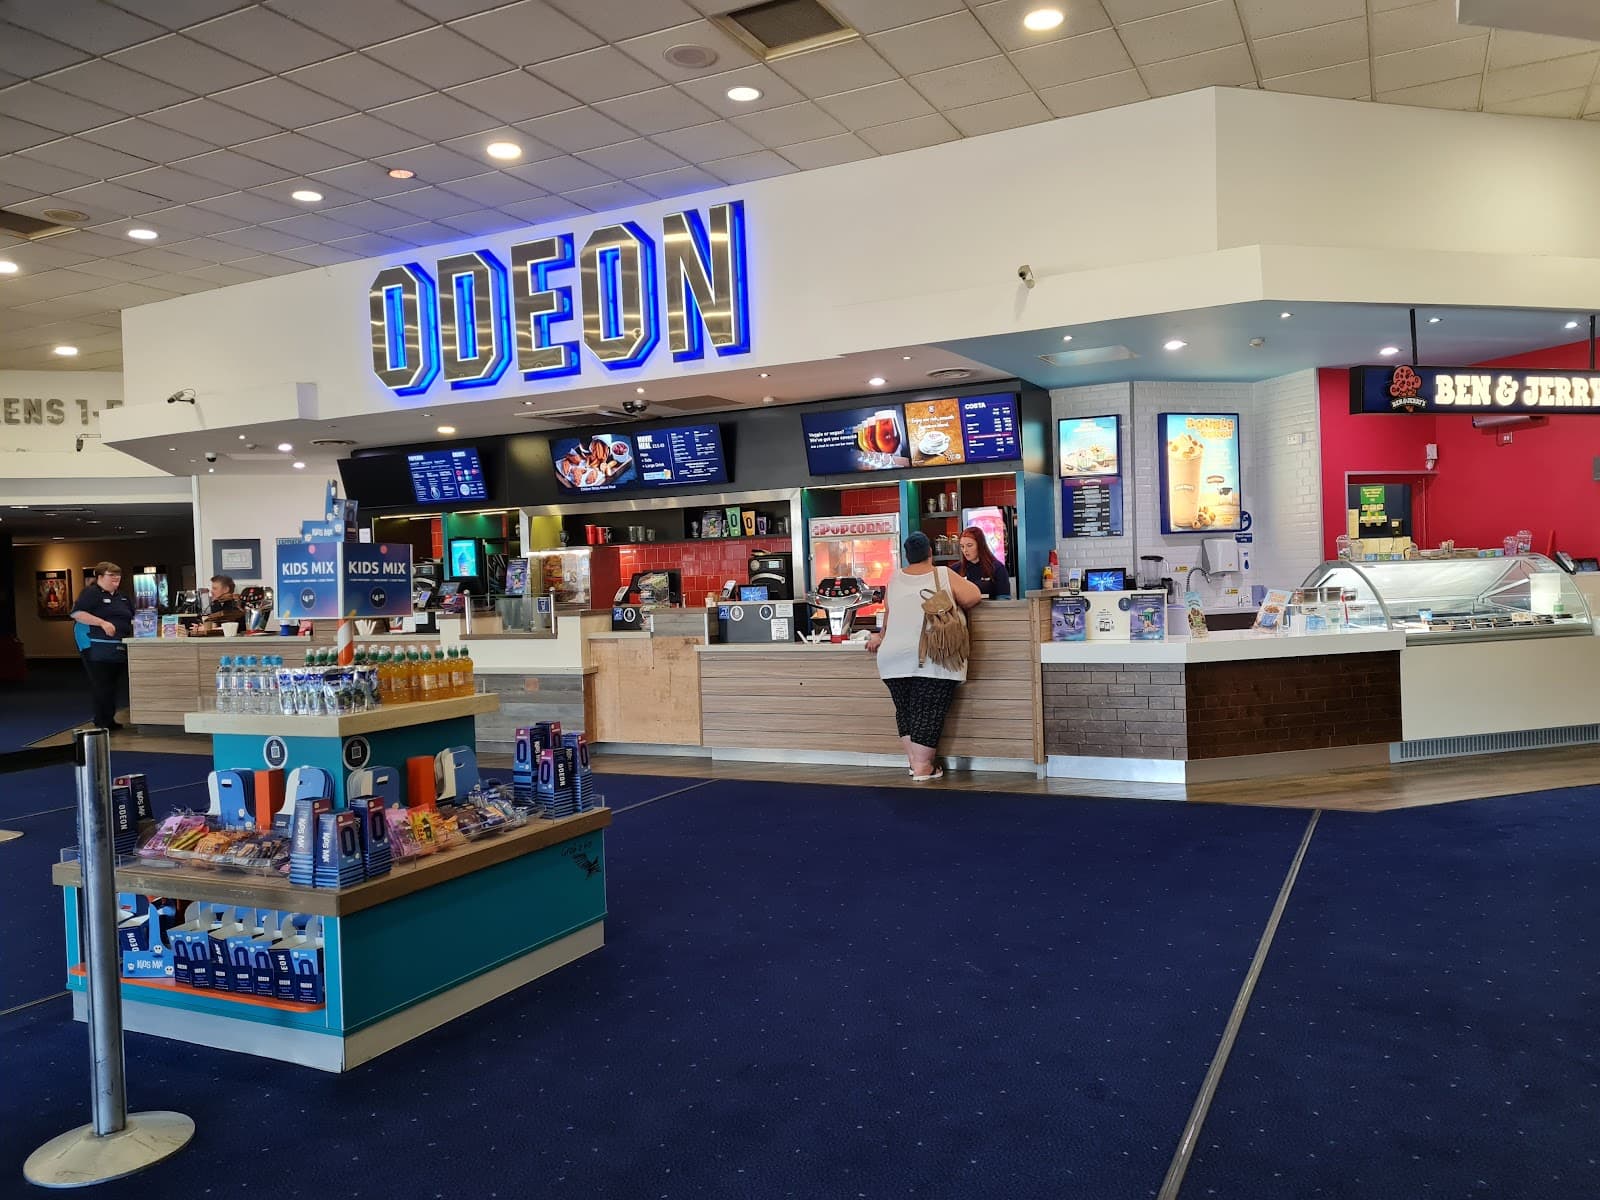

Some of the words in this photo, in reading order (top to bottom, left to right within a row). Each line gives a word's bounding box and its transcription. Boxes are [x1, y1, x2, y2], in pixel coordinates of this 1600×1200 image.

[369, 200, 751, 397] ODEON
[1435, 375, 1491, 405] BEN
[1496, 375, 1519, 406] &
[0, 397, 65, 425] ENS
[820, 521, 890, 536] POPCORN
[282, 562, 308, 575] KIDS
[311, 561, 334, 575] MIX
[348, 561, 379, 574] KIDS
[382, 562, 406, 575] MIX
[558, 763, 566, 786] ODEON
[118, 804, 128, 830] ODEON
[126, 933, 140, 951] DEON
[136, 960, 151, 968] KIDS
[152, 960, 163, 968] MIX
